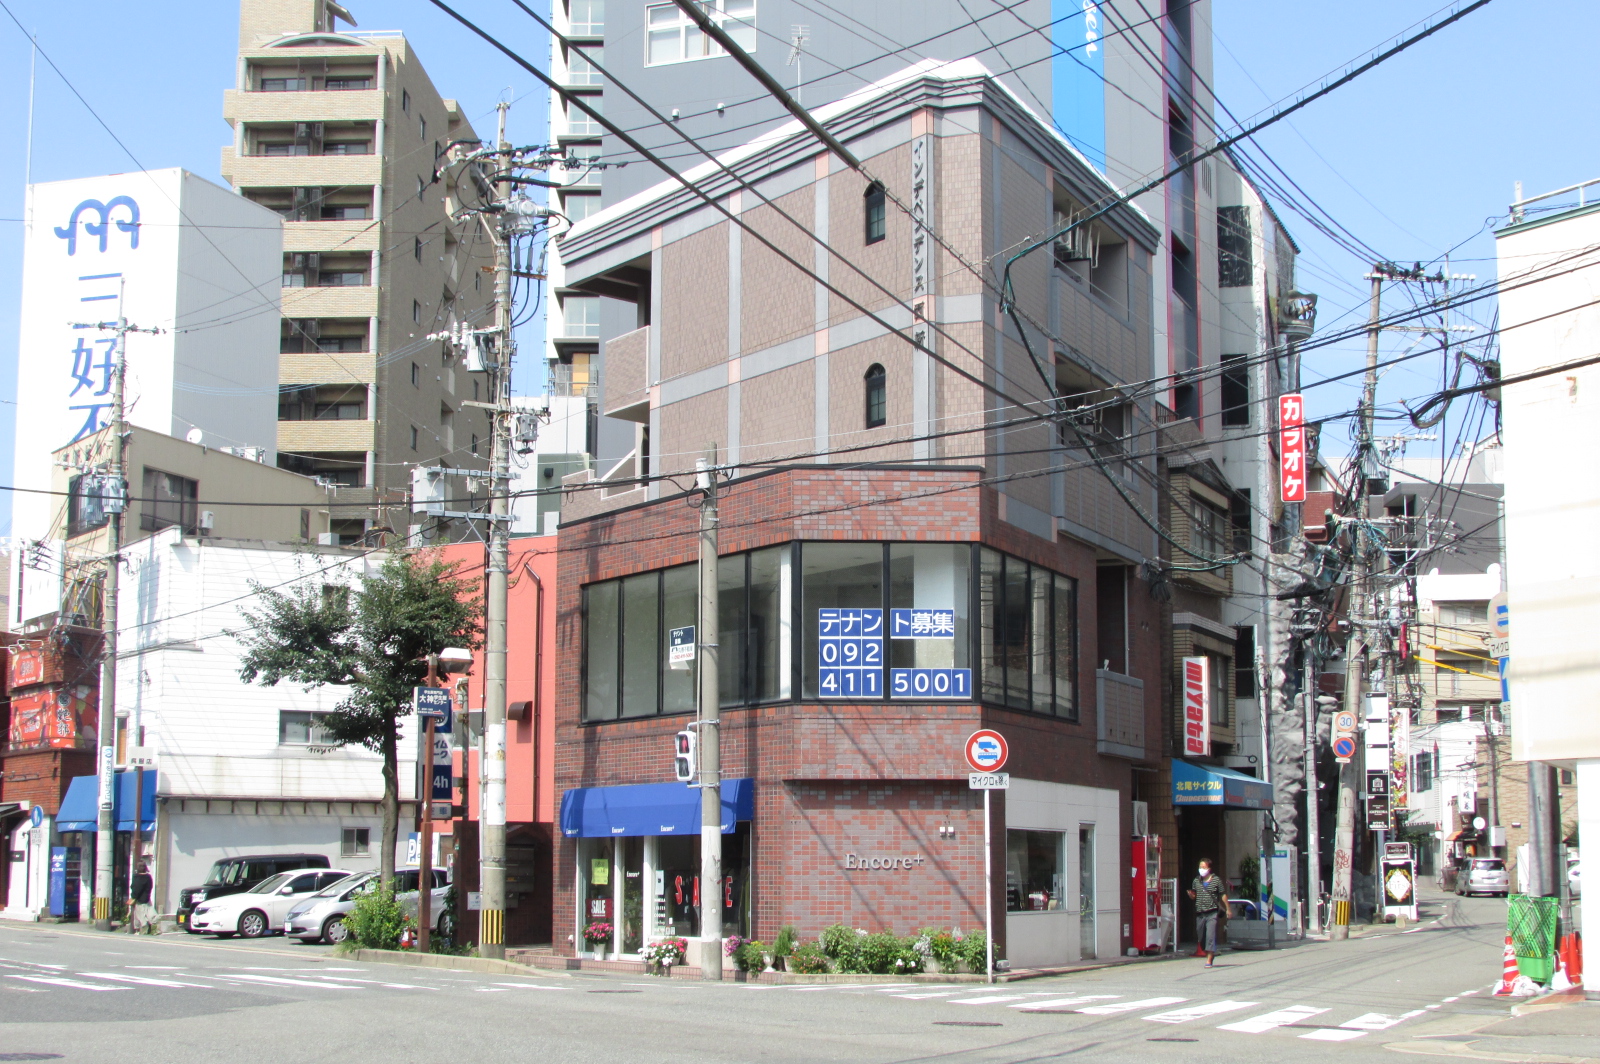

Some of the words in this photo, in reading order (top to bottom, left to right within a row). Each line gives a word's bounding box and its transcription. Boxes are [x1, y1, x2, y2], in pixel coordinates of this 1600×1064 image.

[1283, 398, 1302, 498] カラオケ
[822, 643, 879, 663] 092
[822, 673, 876, 692] 411
[894, 673, 964, 693] 5001
[1340, 717, 1352, 727] 30
[433, 775, 449, 789] 4h
[971, 775, 1008, 786] マイクロを除く
[1176, 781, 1222, 791] 北尾サイクル
[845, 854, 925, 870] Encore+
[675, 875, 733, 908] SAE
[591, 900, 606, 914] SALE
